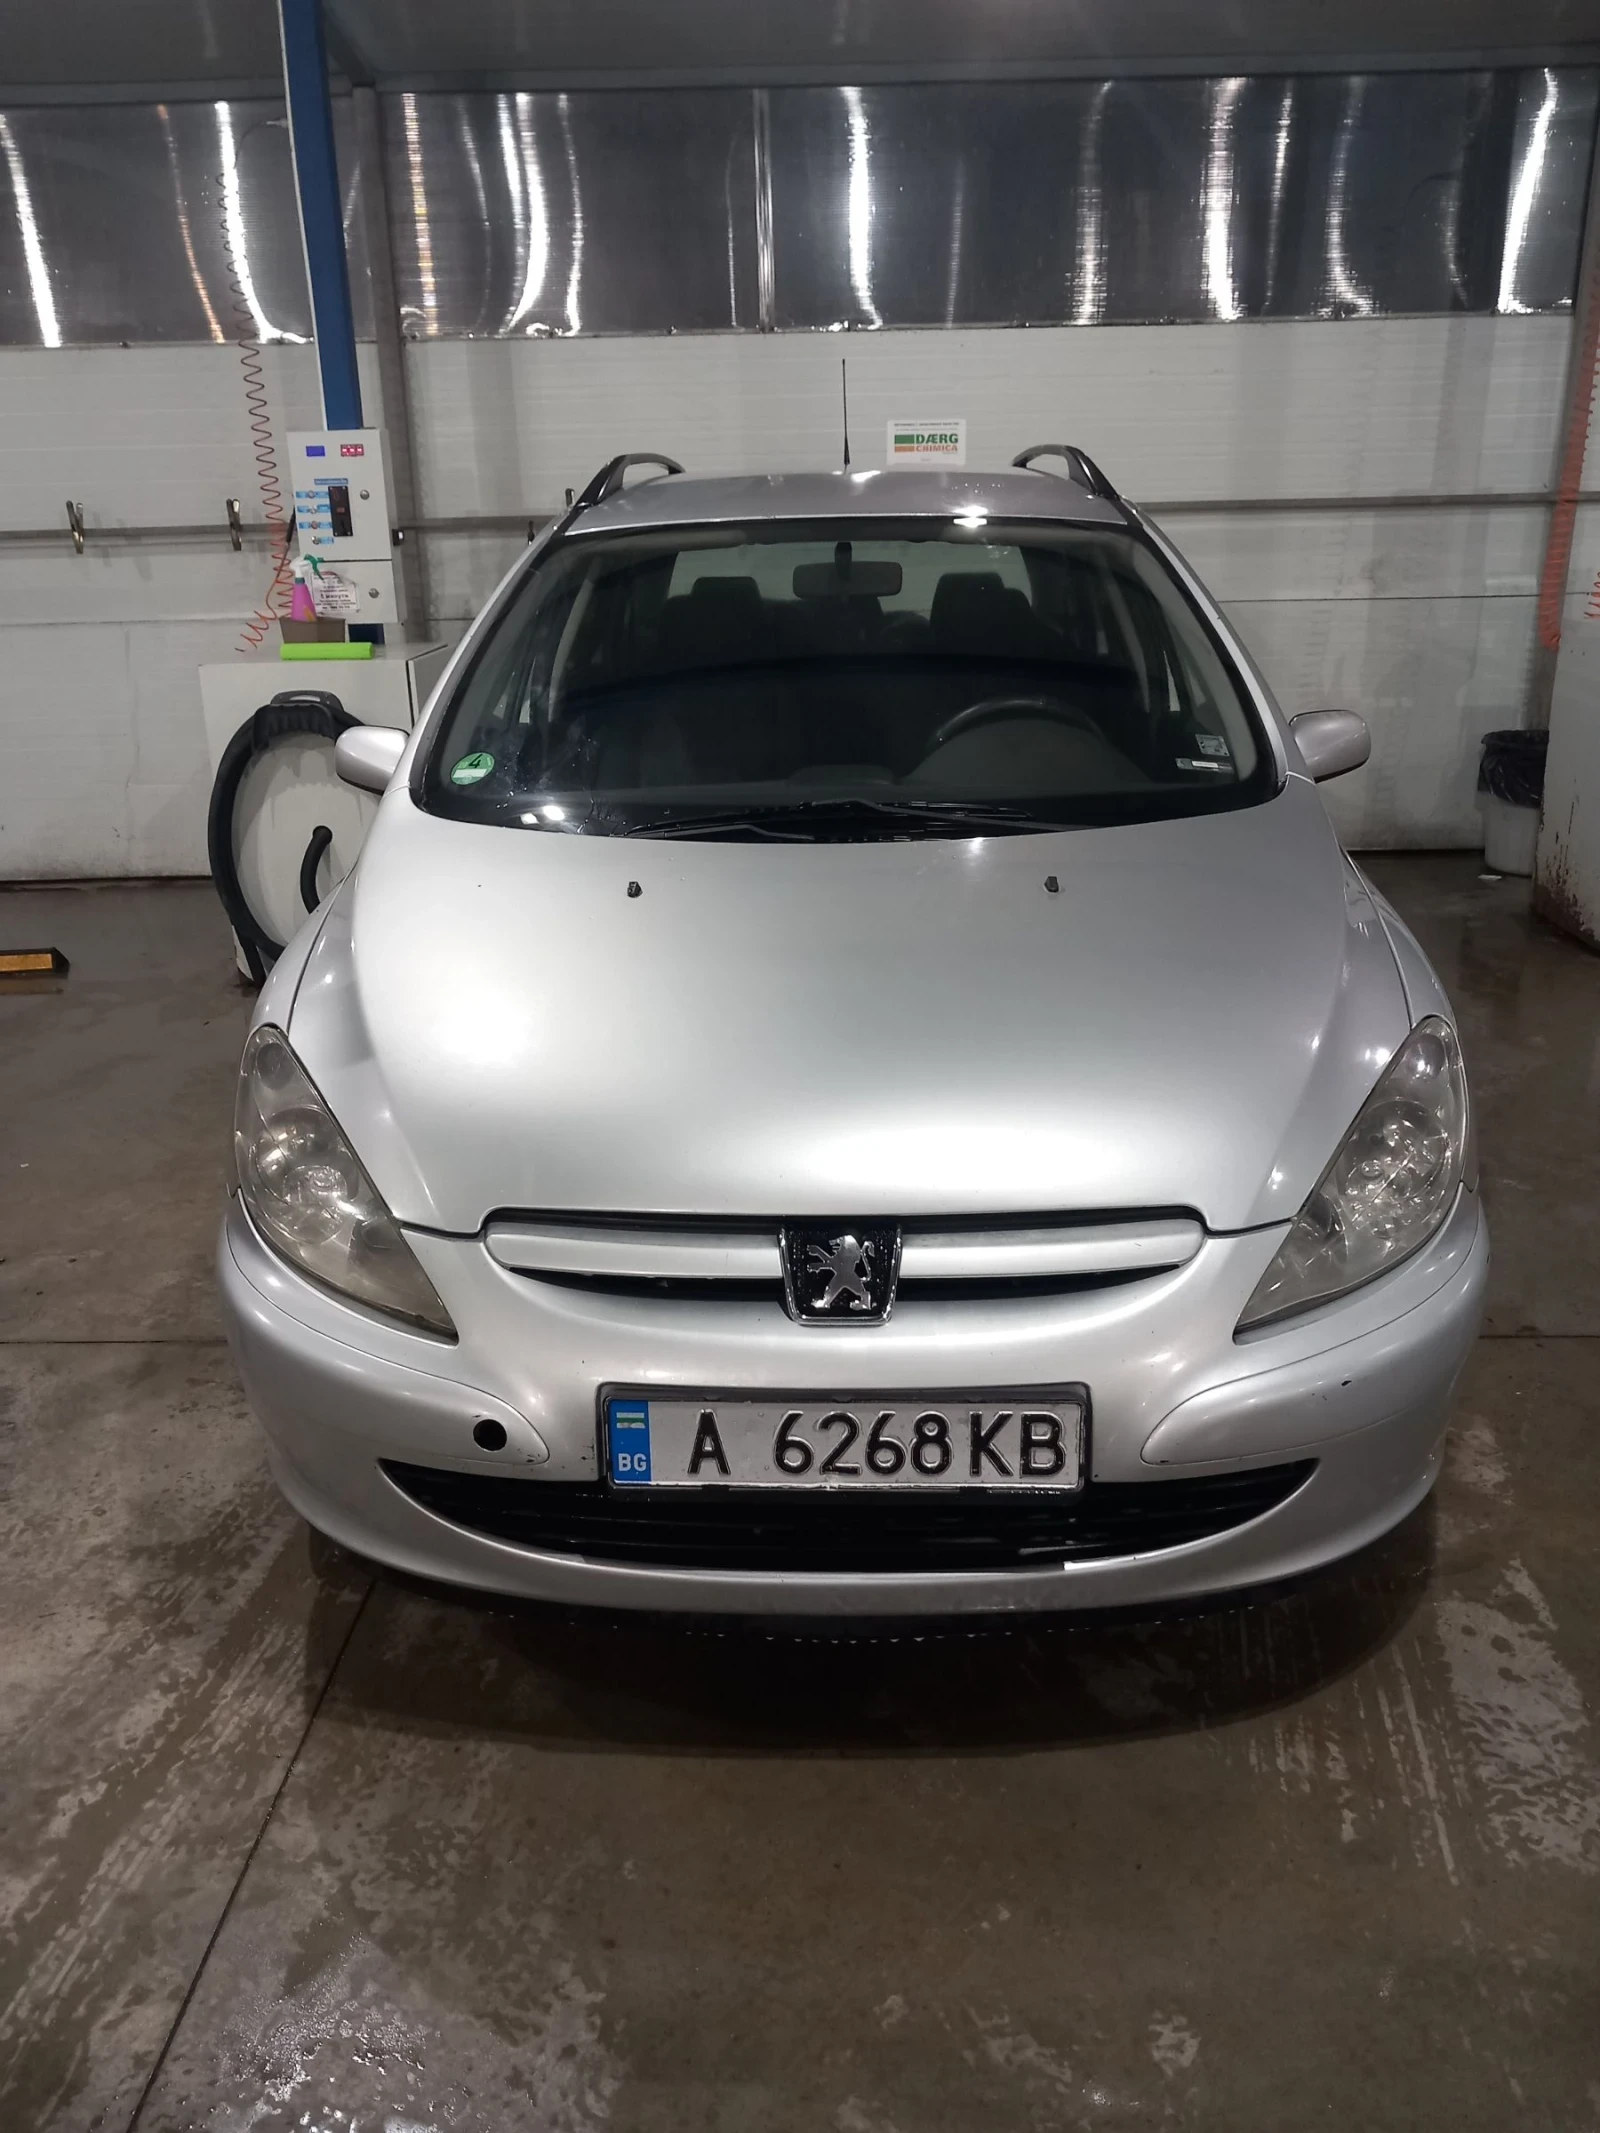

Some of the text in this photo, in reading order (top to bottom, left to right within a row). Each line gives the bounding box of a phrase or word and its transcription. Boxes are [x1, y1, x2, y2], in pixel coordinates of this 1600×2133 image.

[468, 753, 484, 769] 4
[687, 1408, 731, 1475] A
[618, 1453, 647, 1471] BG
